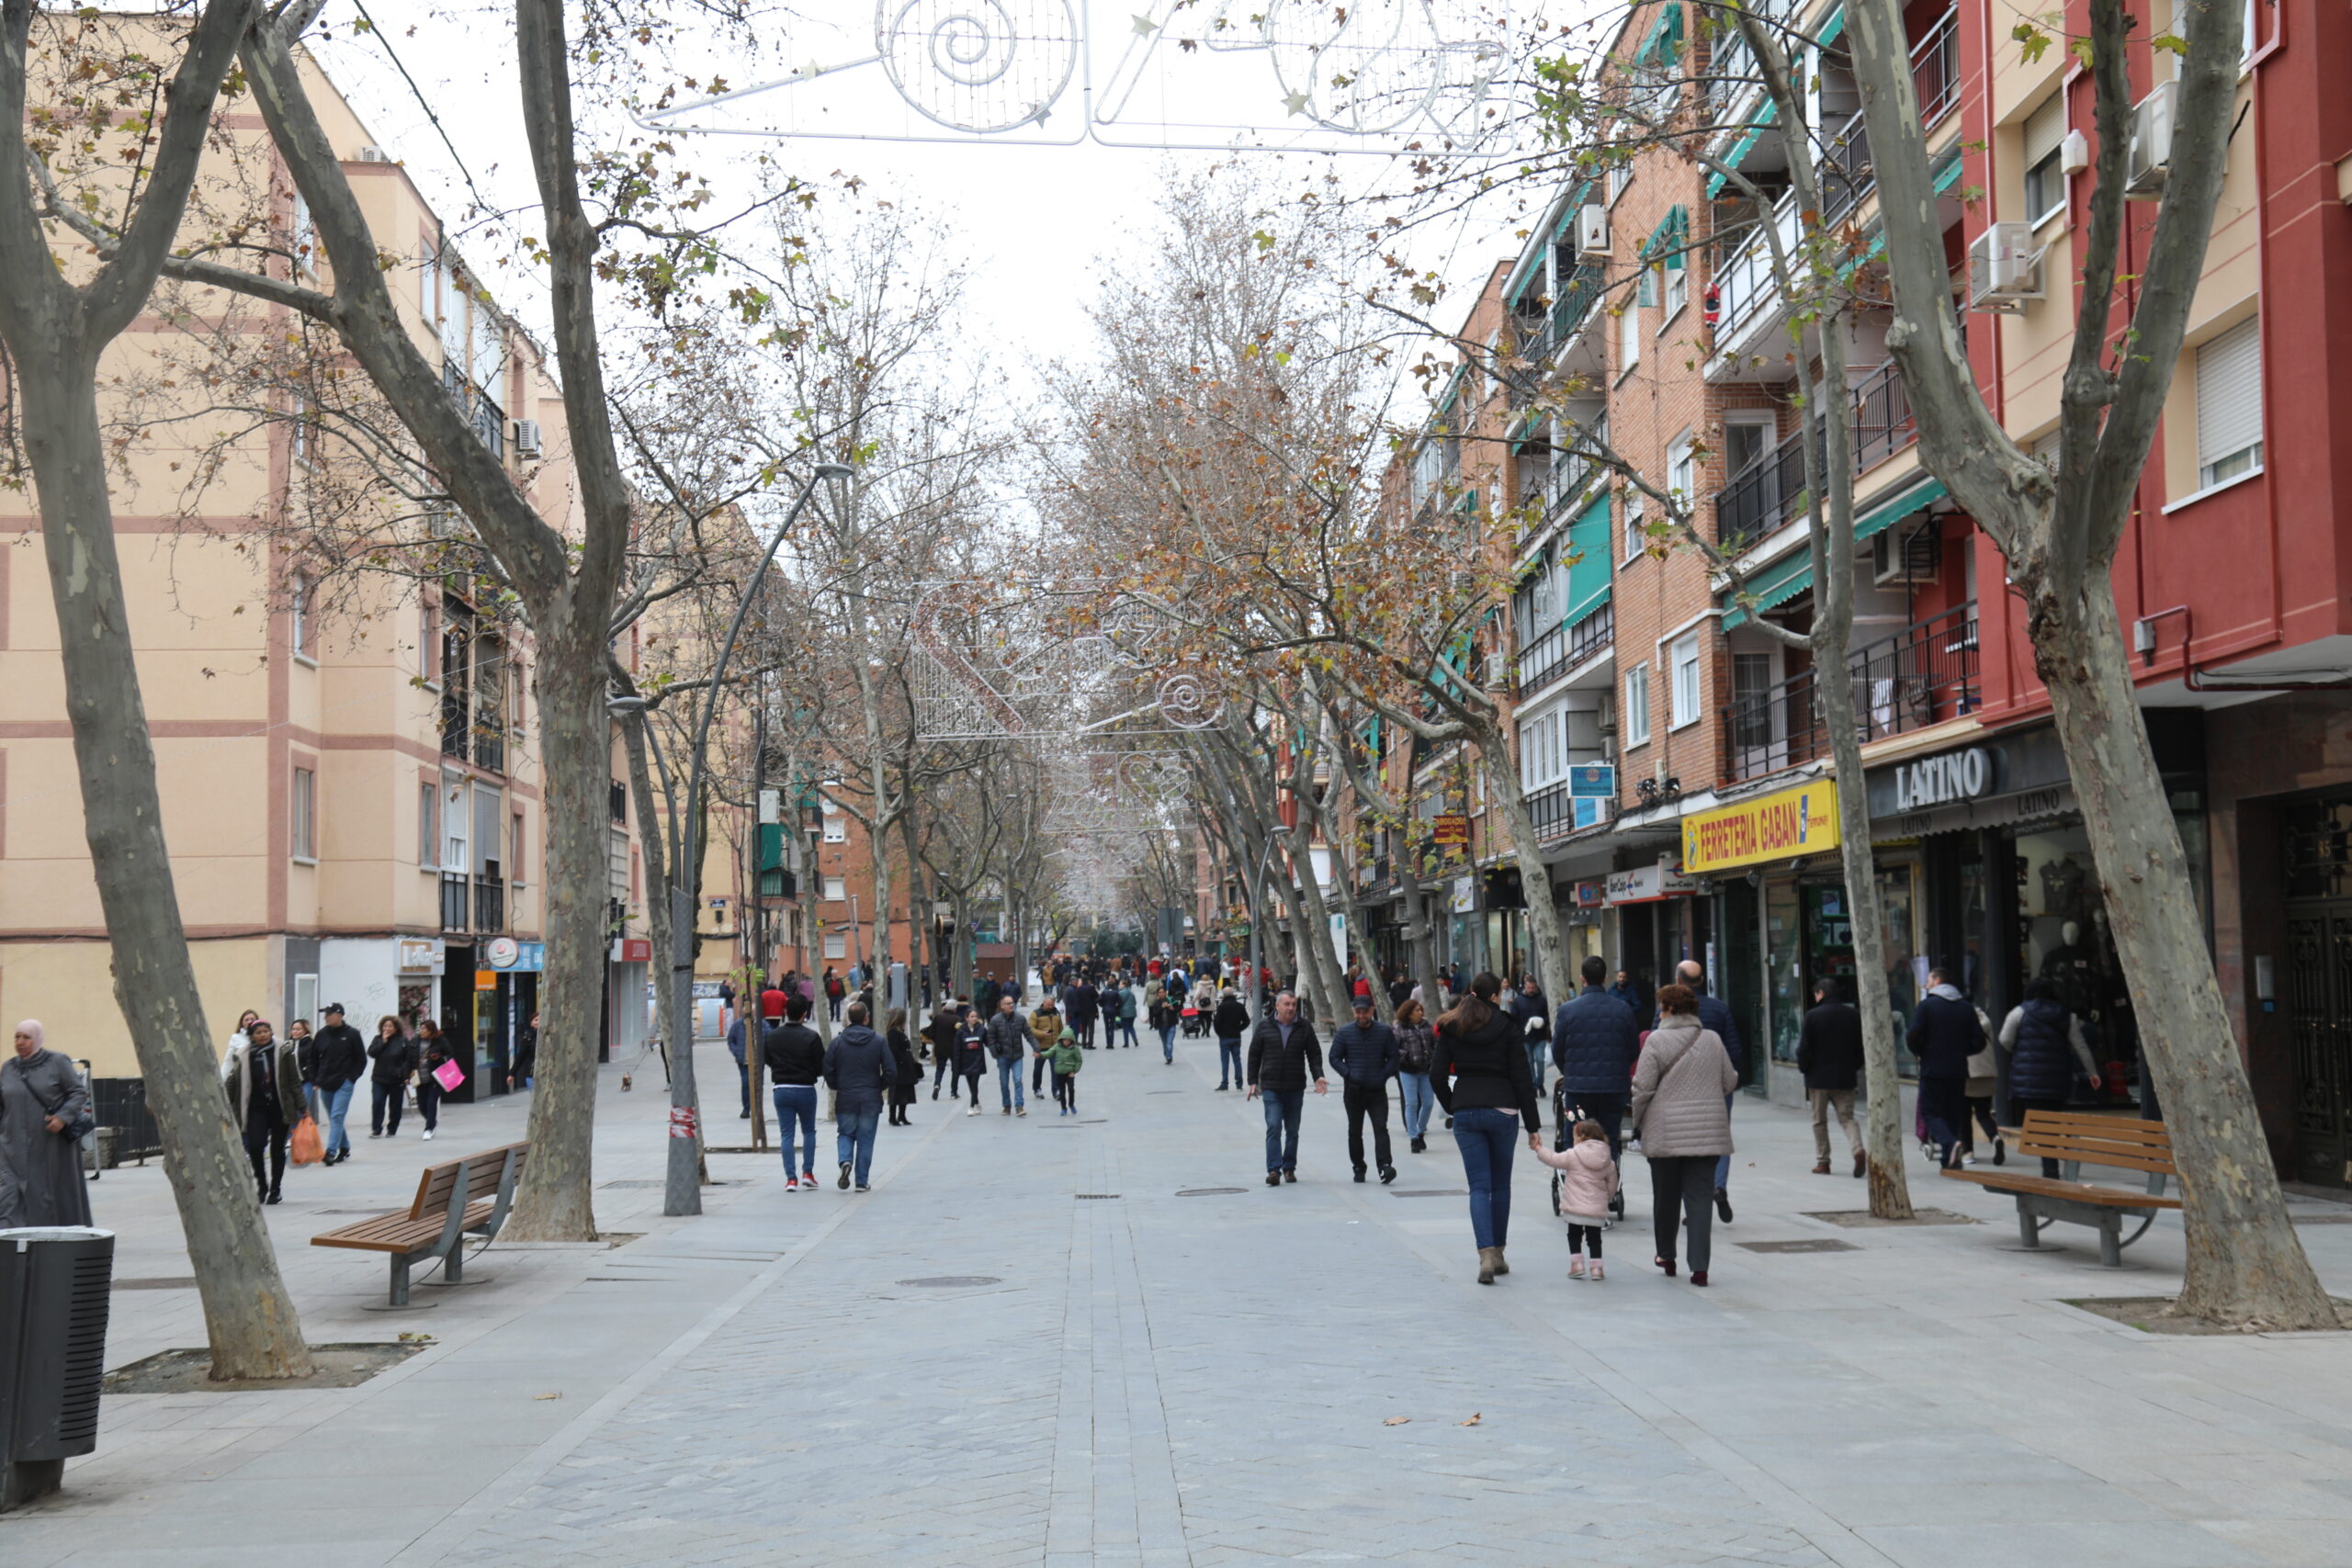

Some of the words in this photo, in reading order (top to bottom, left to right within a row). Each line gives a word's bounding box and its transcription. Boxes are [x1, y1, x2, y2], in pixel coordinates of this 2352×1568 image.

[1895, 748, 1984, 812] LATINO
[1901, 814, 1931, 835] LATINO
[2017, 789, 2060, 816] LATINO
[1700, 812, 1757, 863] FERRETERIA
[1760, 801, 1797, 852] GABAN
